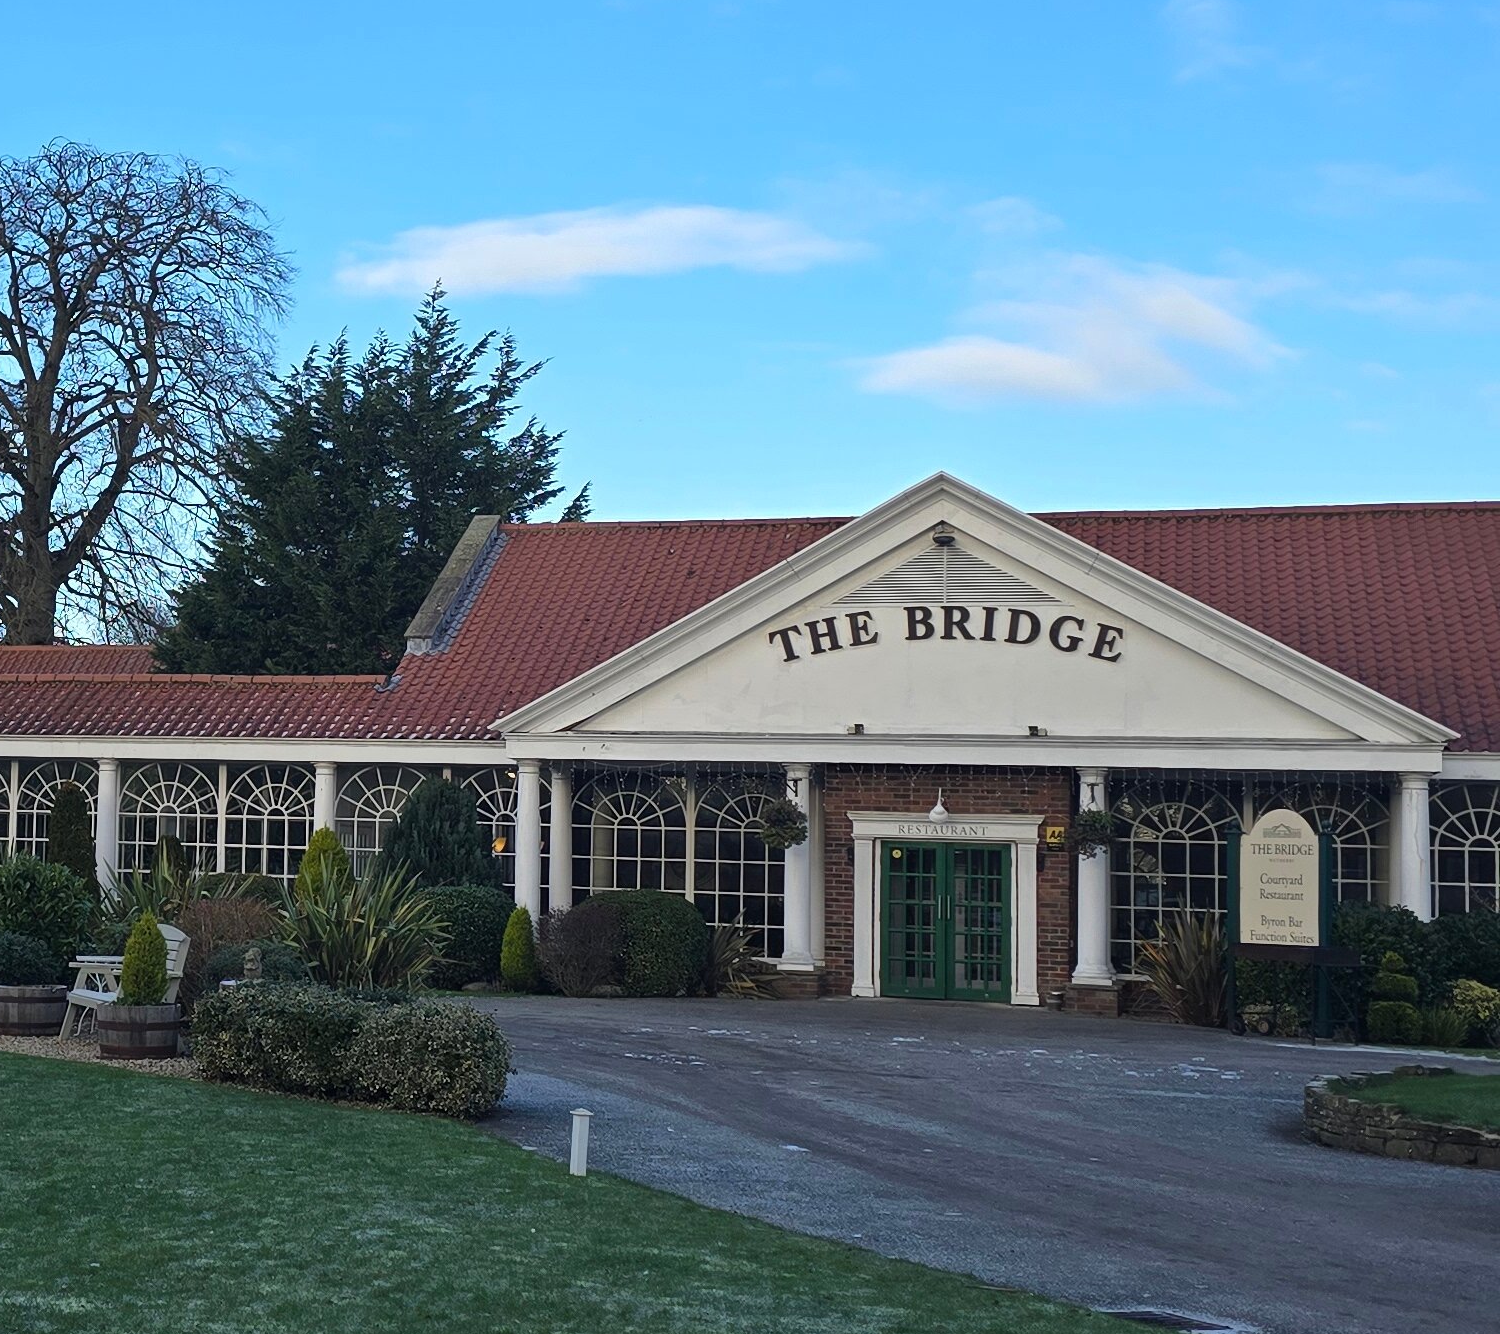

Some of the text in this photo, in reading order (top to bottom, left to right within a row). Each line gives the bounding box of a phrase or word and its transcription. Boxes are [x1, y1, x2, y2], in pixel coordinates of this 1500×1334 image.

[768, 605, 1124, 663] THE BRIDGE
[898, 824, 989, 837] RESTAURANT
[1049, 830, 1064, 840] AA
[1251, 843, 1315, 856] THE BRIDGE
[1260, 872, 1304, 888] Courtyard
[1260, 888, 1304, 901] Restaurant
[1260, 914, 1304, 929] Byron Bar
[1250, 929, 1315, 944] Function Suites
